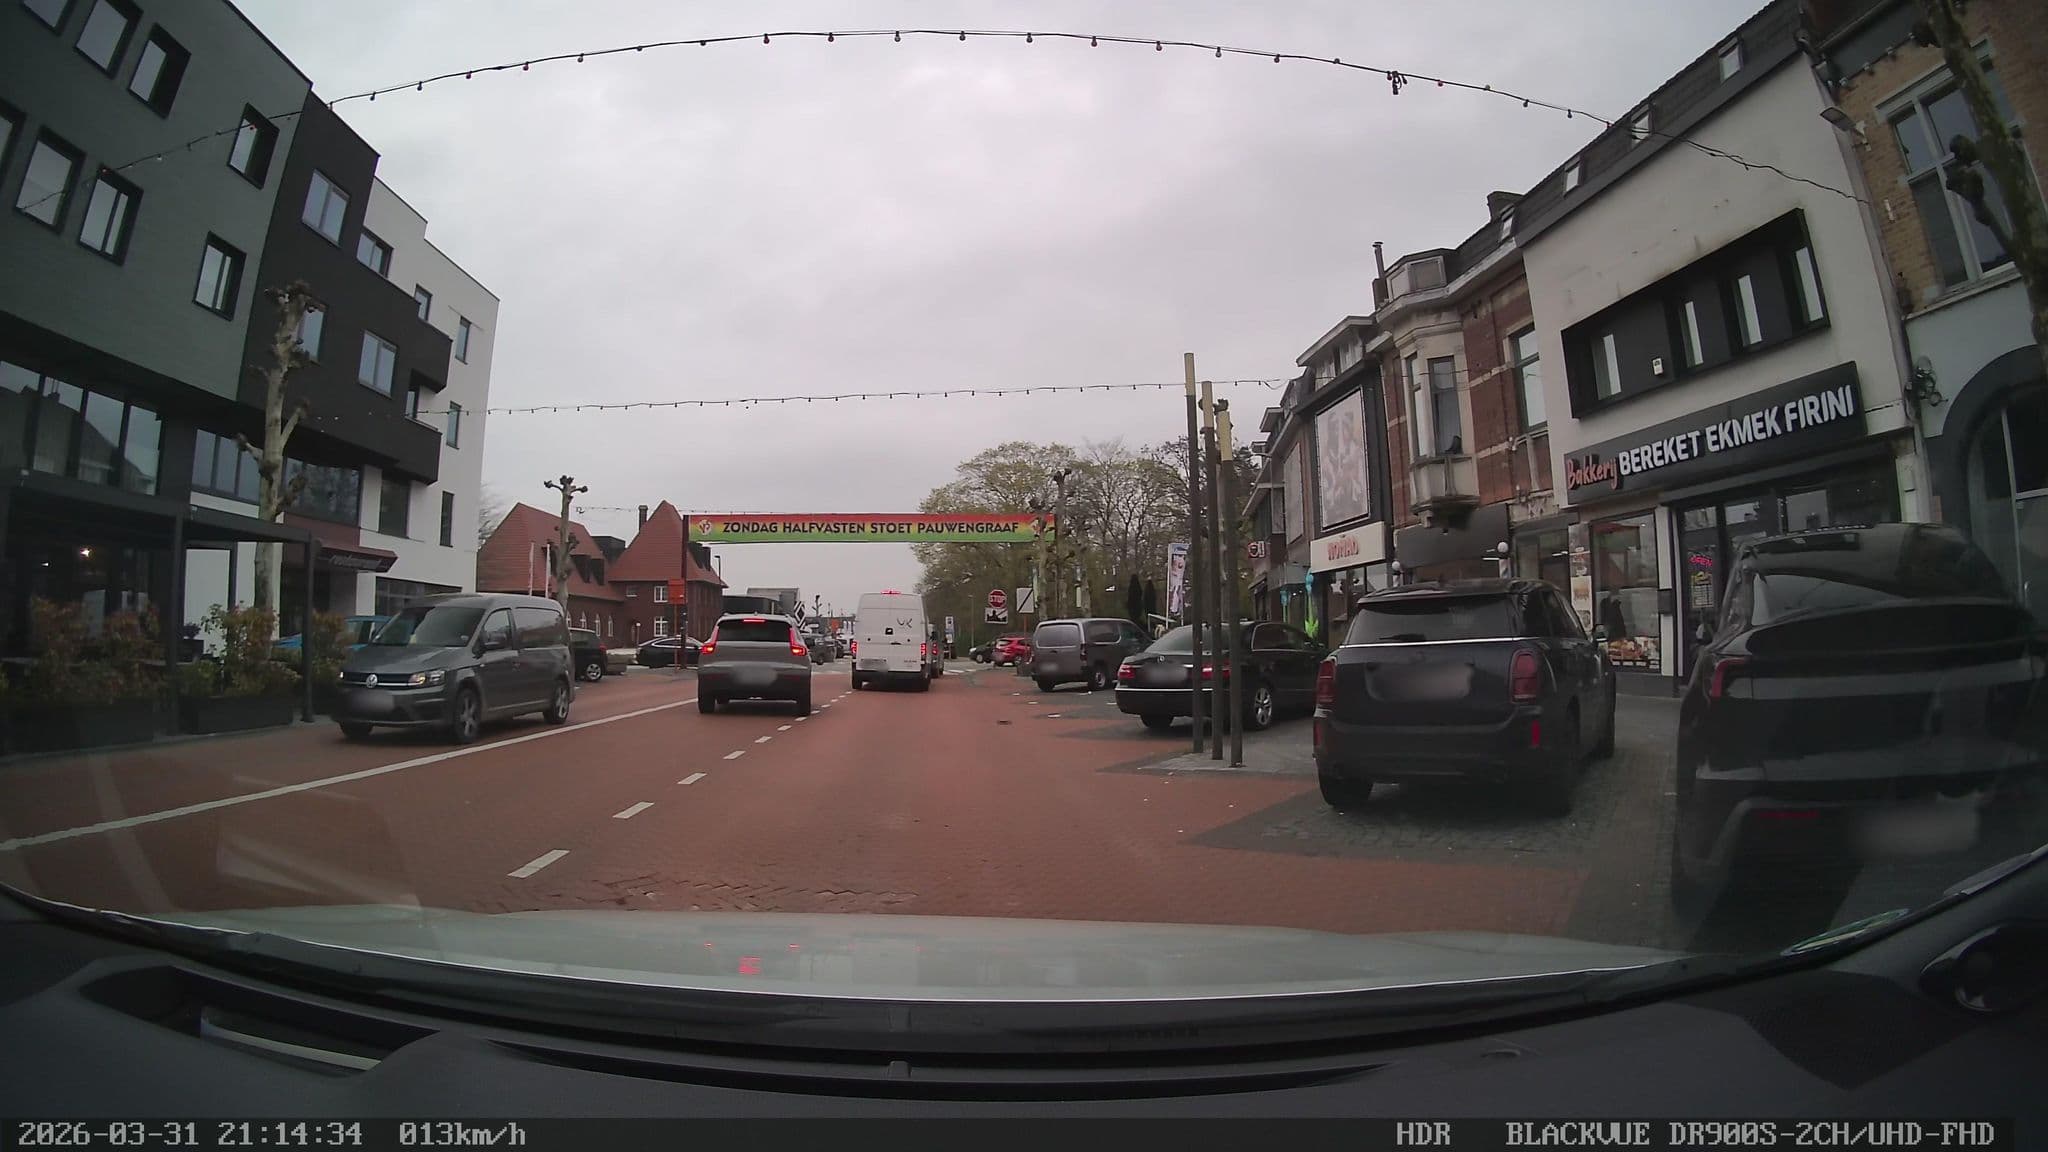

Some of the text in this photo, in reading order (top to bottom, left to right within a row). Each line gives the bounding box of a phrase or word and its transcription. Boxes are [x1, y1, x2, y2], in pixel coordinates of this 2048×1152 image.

[1566, 384, 1855, 490] Bakkerij BEREKET EKMEK FIRINI
[723, 522, 1019, 534] ZONDAG HALFVASTEN STOET PAUWENGRAAF
